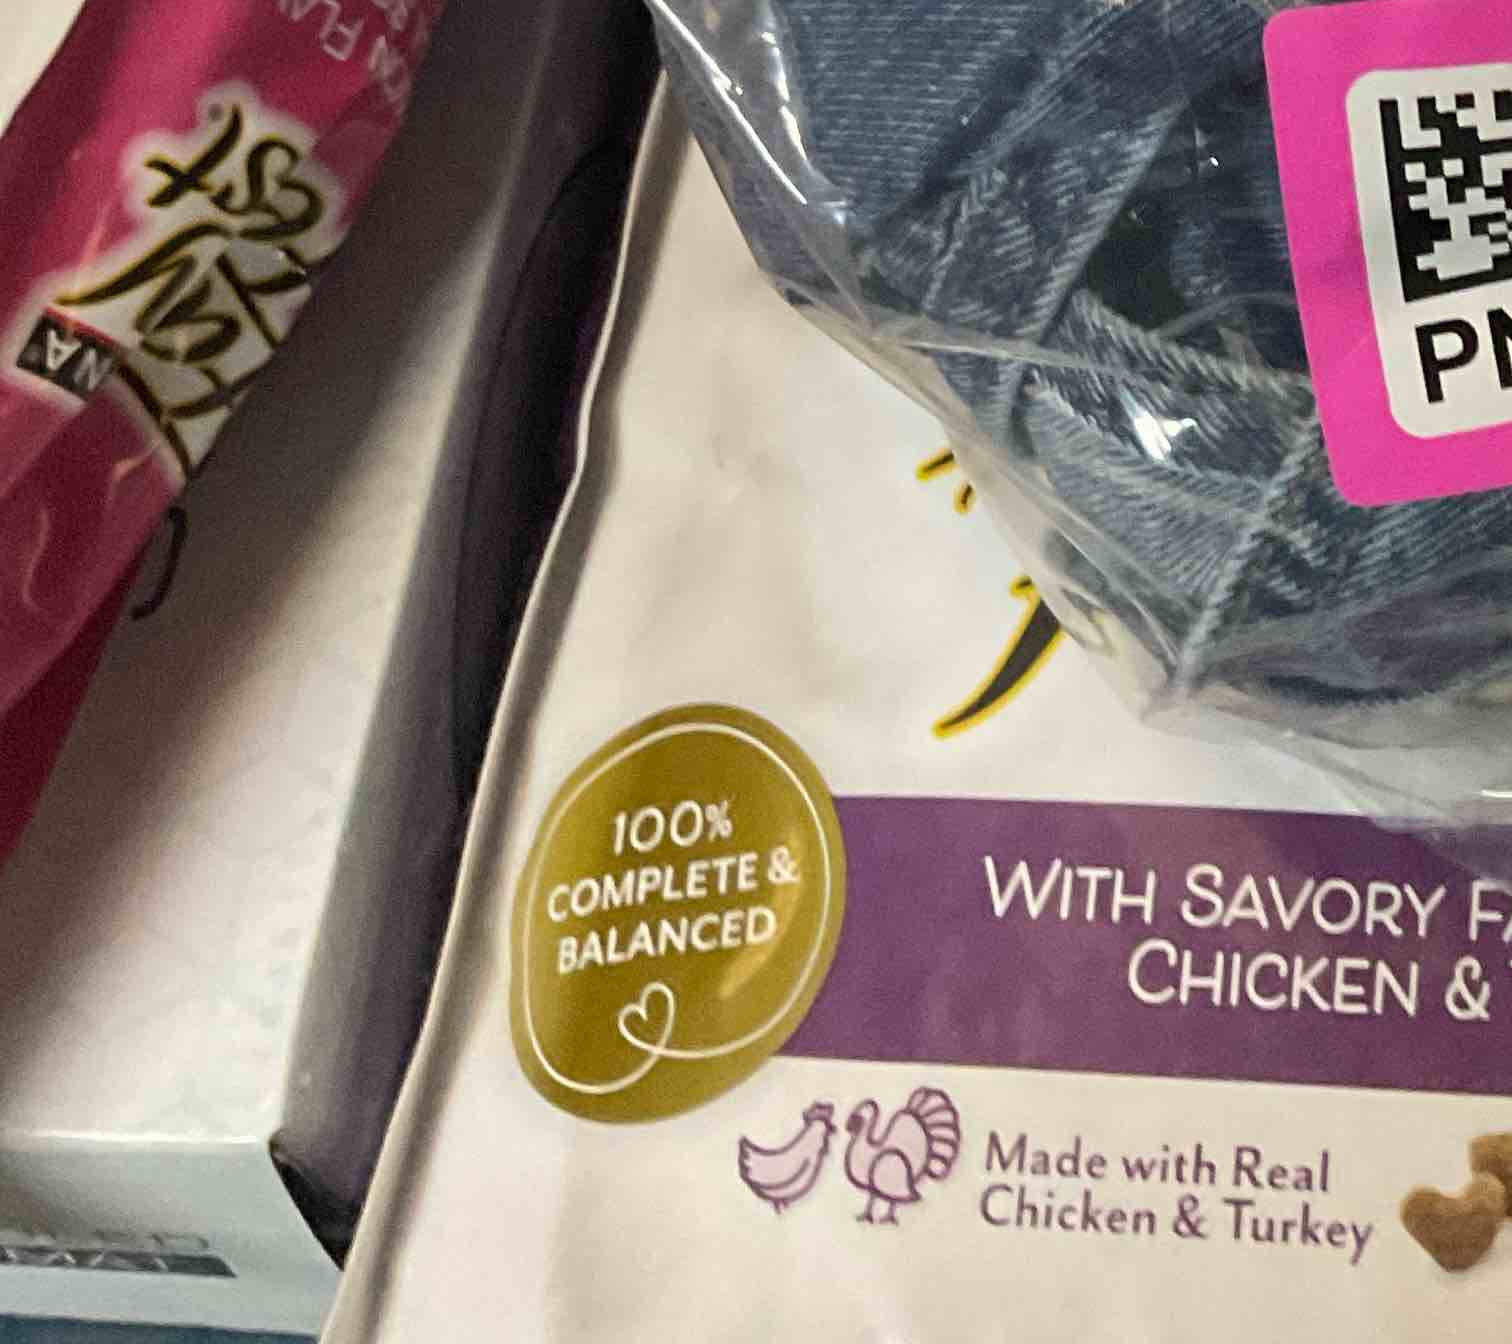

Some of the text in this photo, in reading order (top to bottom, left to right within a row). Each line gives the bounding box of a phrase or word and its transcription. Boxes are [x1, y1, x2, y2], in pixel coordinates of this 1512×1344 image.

[612, 799, 734, 858] 100%
[547, 845, 801, 924] COMPLETE &
[984, 856, 1156, 926] WITH
[1180, 863, 1447, 938] SAVORY
[555, 906, 778, 976] BALANCED
[1128, 936, 1417, 1017] CHICKEN
[1444, 956, 1491, 1021] &
[985, 1133, 1330, 1194] Made with Real
[979, 1187, 1376, 1267] Chicken & Turkey
